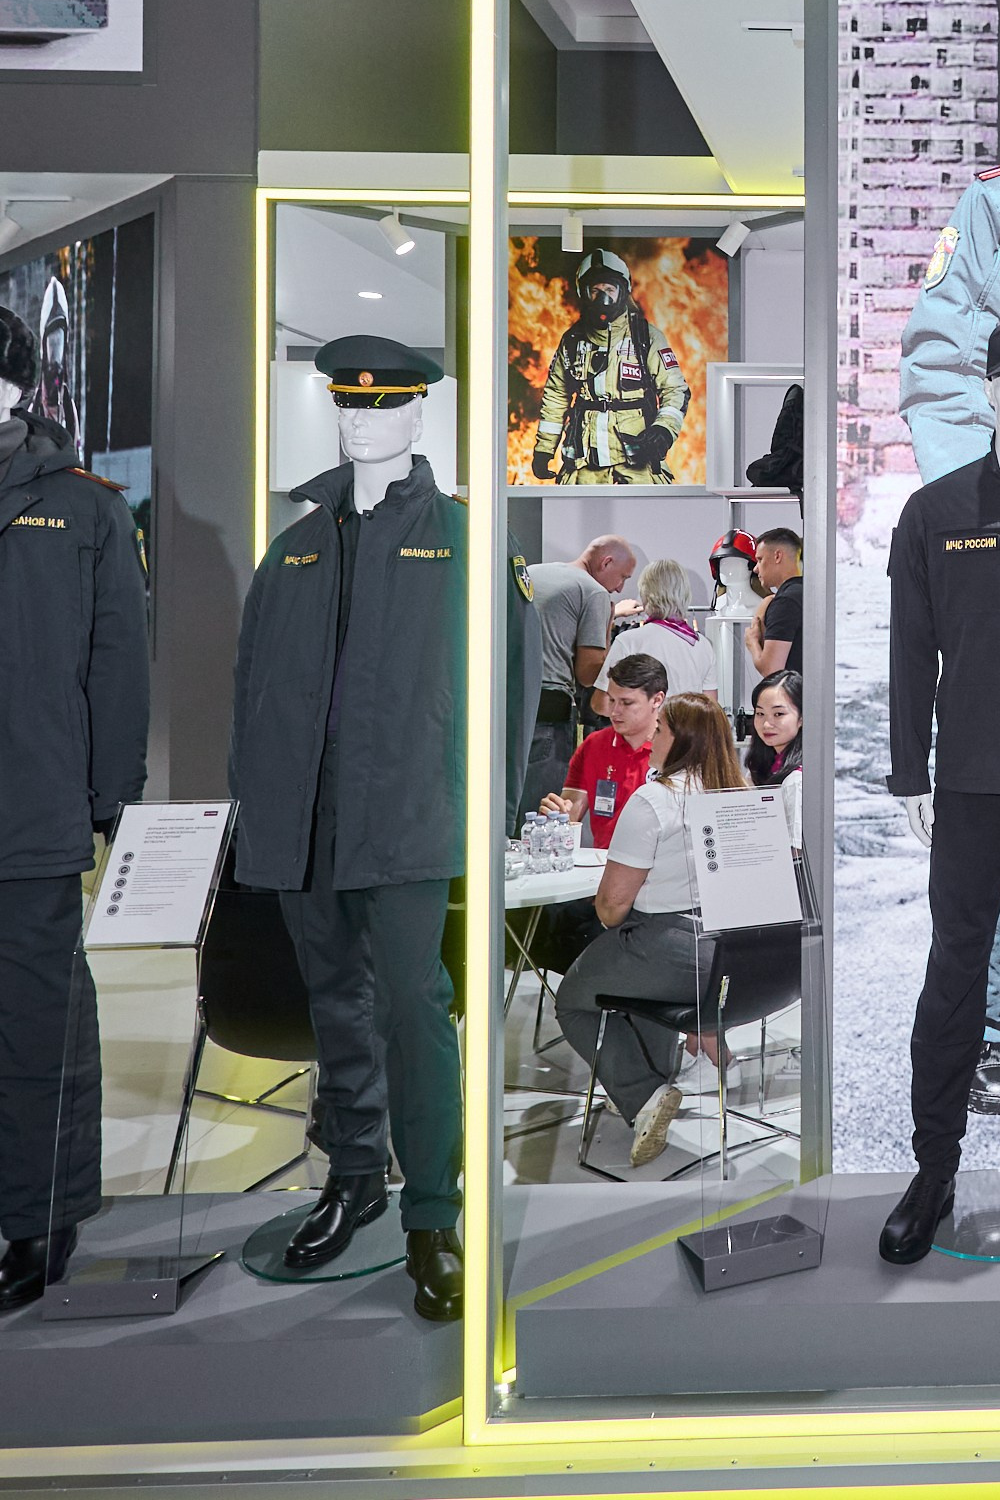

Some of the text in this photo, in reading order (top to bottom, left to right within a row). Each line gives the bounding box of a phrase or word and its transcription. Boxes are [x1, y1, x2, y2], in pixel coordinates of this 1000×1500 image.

[622, 365, 640, 377] БТК
[945, 537, 997, 551] МЧС РОССИИ
[399, 547, 435, 559] ИВАНОВ
